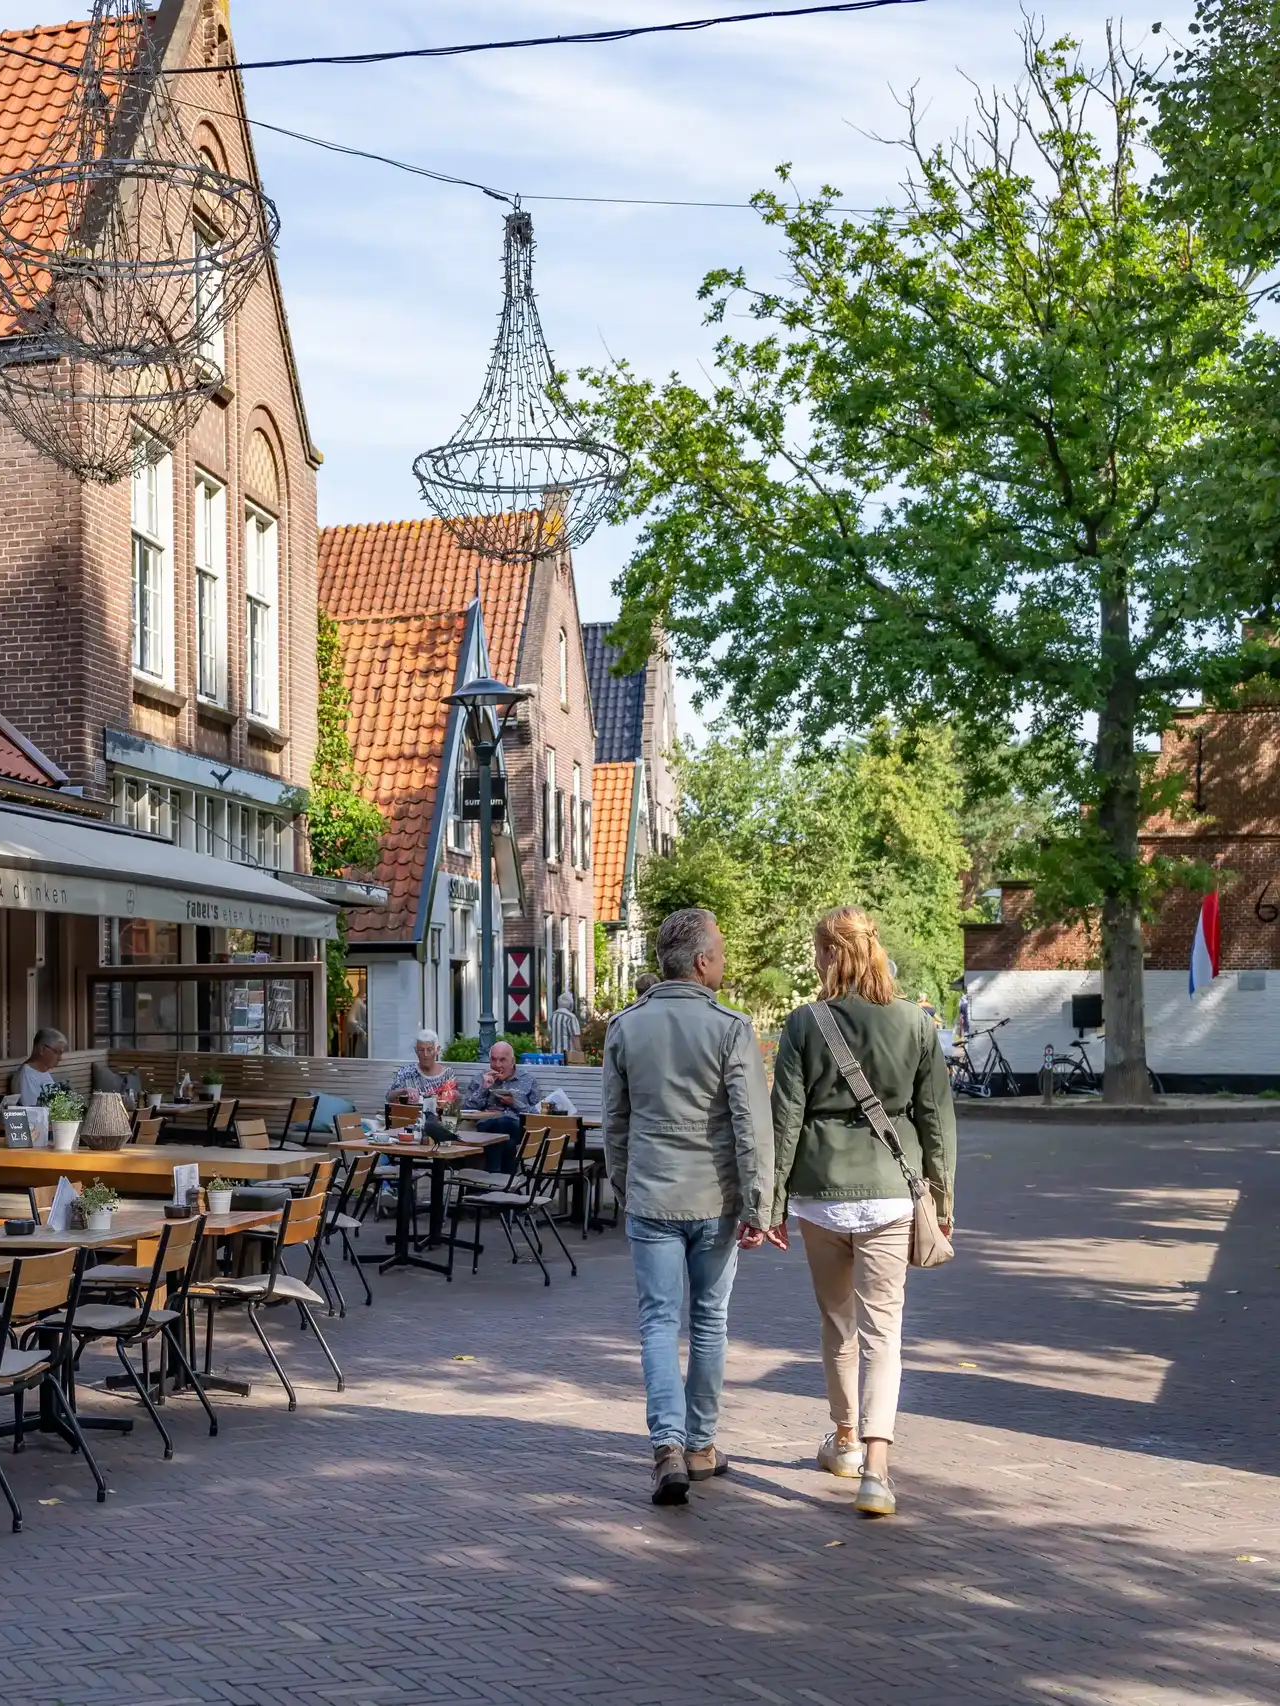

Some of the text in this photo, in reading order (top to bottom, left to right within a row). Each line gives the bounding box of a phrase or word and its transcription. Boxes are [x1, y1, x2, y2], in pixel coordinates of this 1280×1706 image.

[464, 798, 504, 806] sumum
[13, 877, 68, 904] drinken
[186, 900, 219, 920] fabel's
[222, 907, 244, 924] eten
[258, 912, 290, 929] drinken
